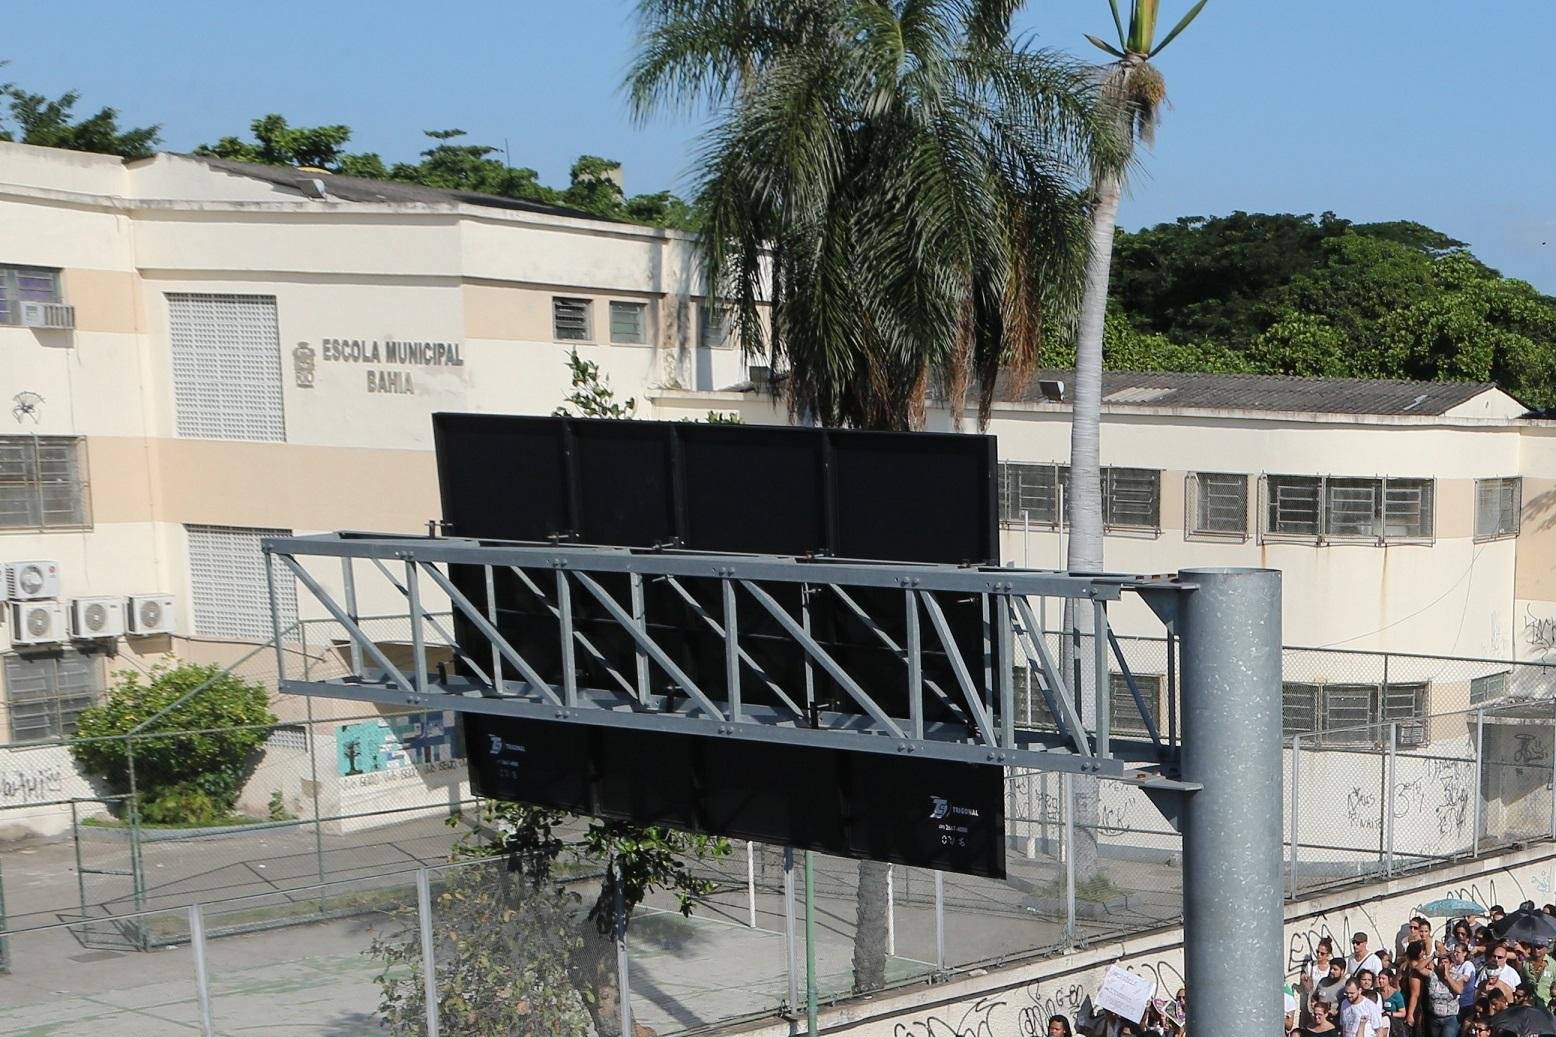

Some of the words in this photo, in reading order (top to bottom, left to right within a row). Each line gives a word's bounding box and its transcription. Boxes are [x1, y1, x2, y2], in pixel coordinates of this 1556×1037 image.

[322, 339, 380, 363] ESCOLA
[385, 341, 464, 366] MUNICIPAL
[367, 370, 414, 394] BAHIA
